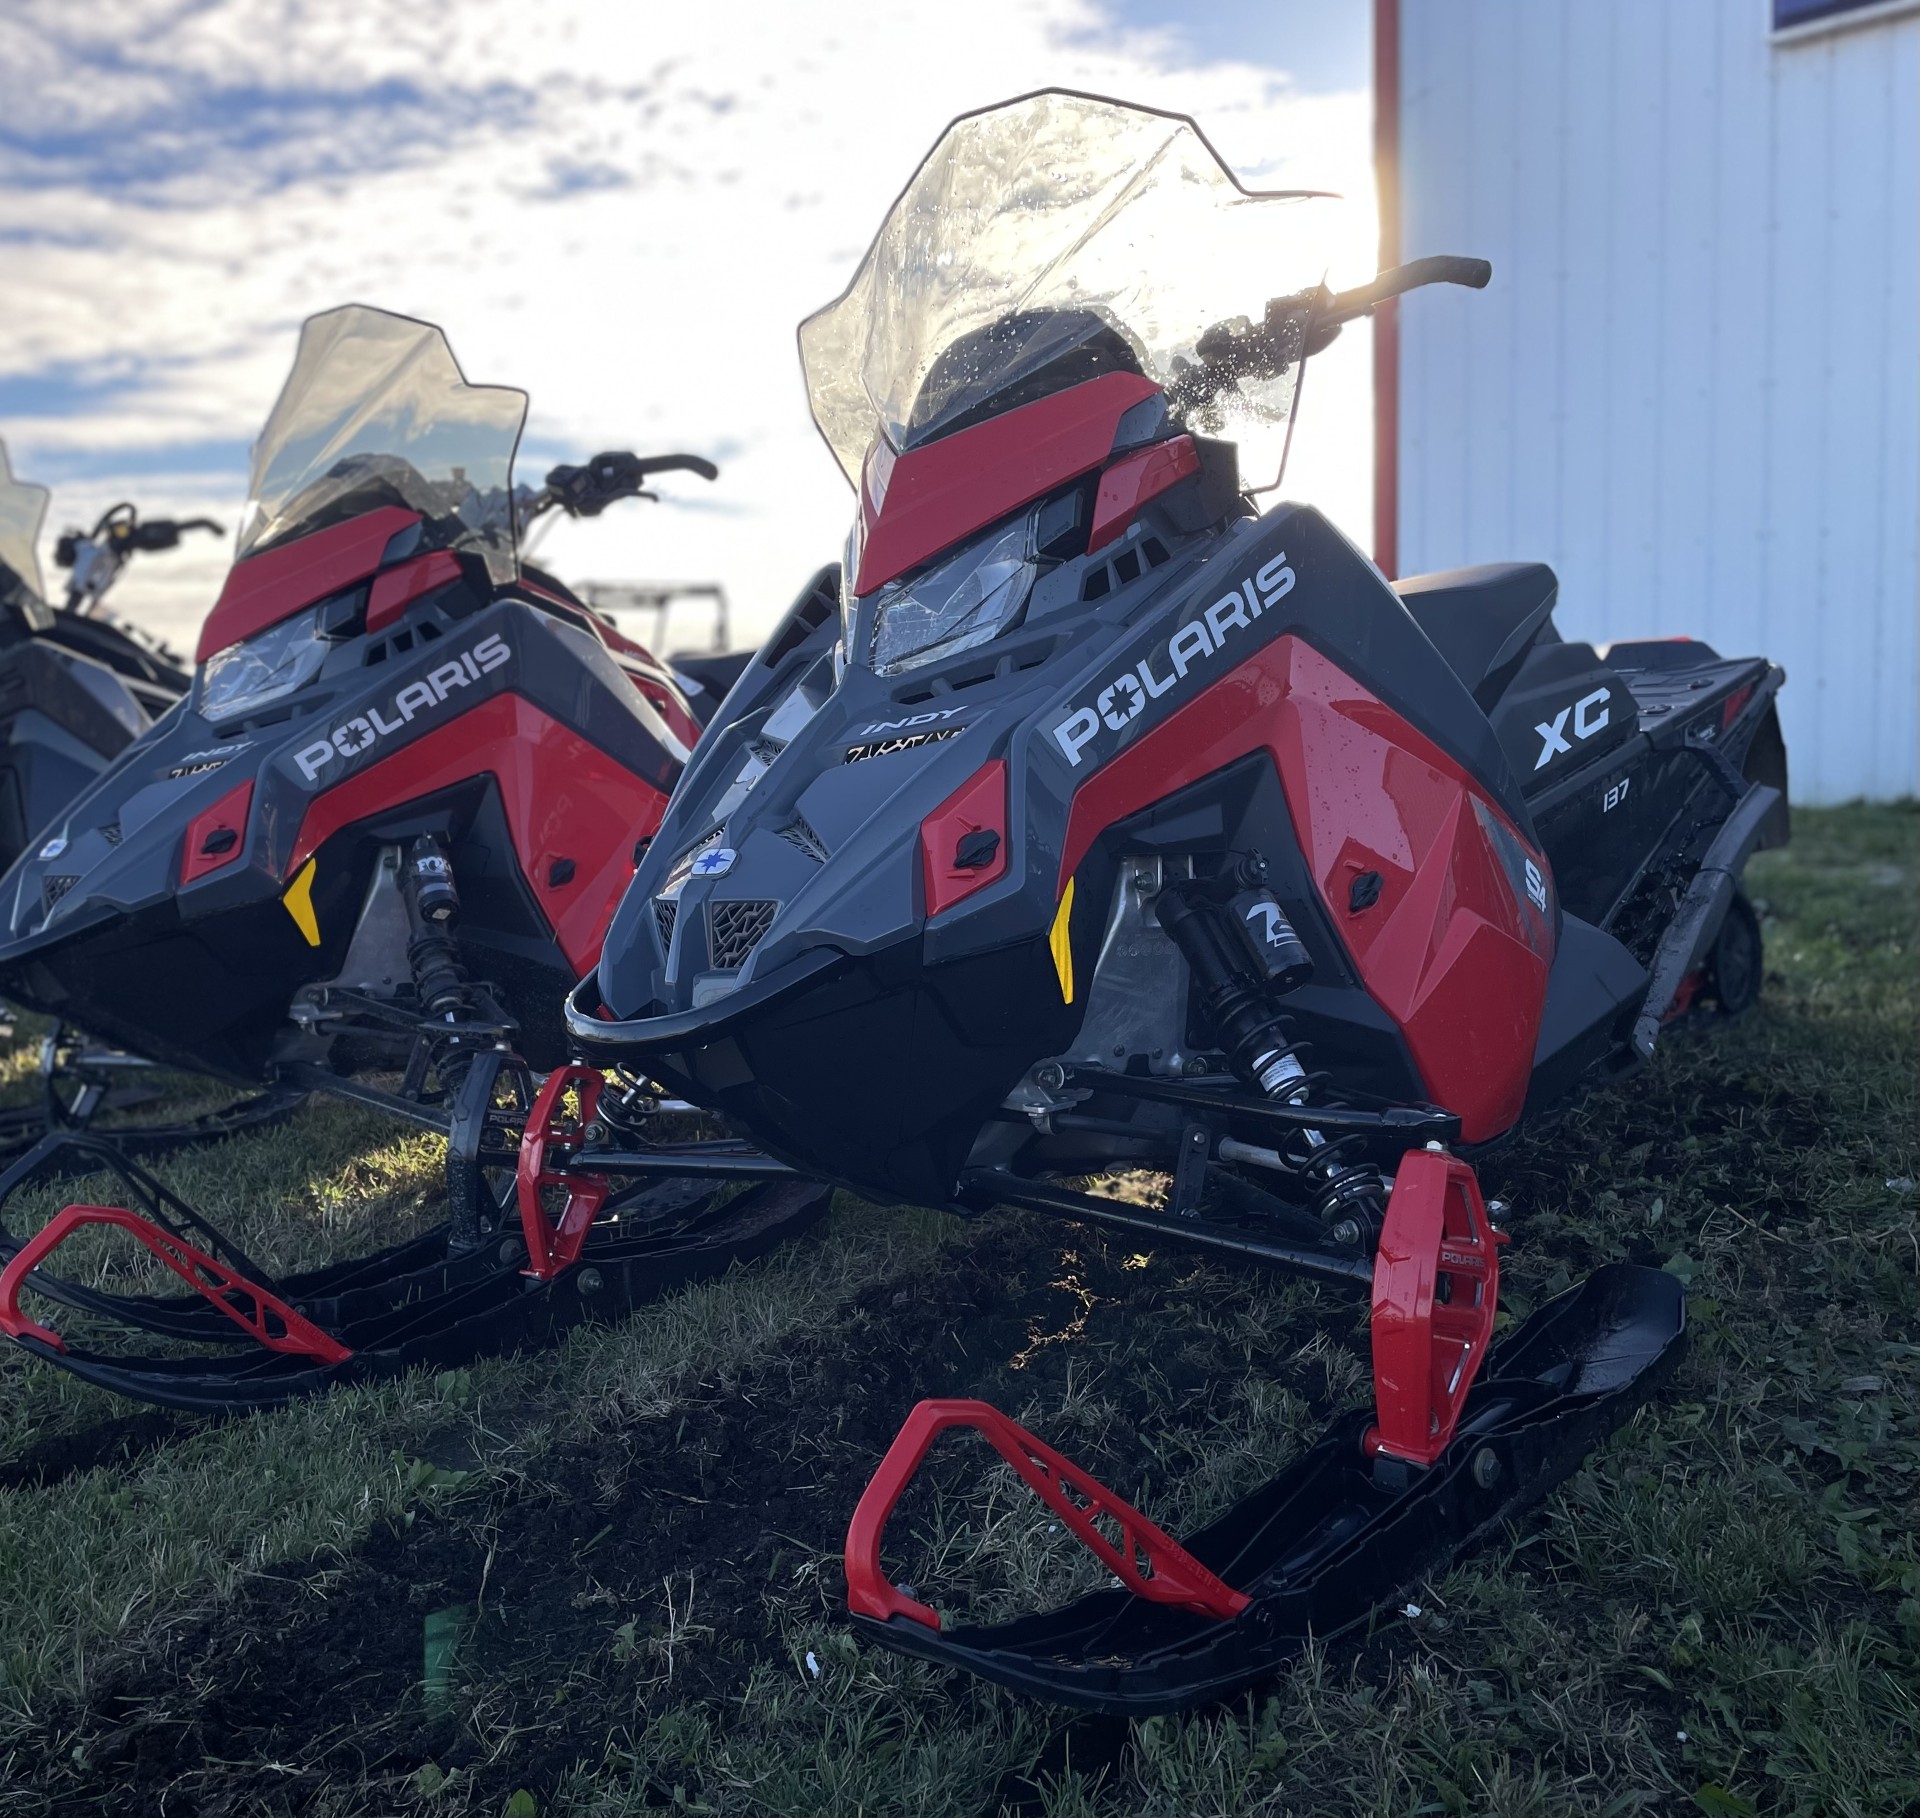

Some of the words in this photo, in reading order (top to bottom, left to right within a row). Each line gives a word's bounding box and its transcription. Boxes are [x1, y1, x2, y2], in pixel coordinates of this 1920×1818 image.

[1053, 551, 1296, 767] POLARIS
[293, 633, 511, 782] POLARIS
[860, 705, 968, 736] INDY
[1534, 687, 1611, 771] XC
[181, 740, 255, 761] INDY
[1603, 777, 1630, 813] 137
